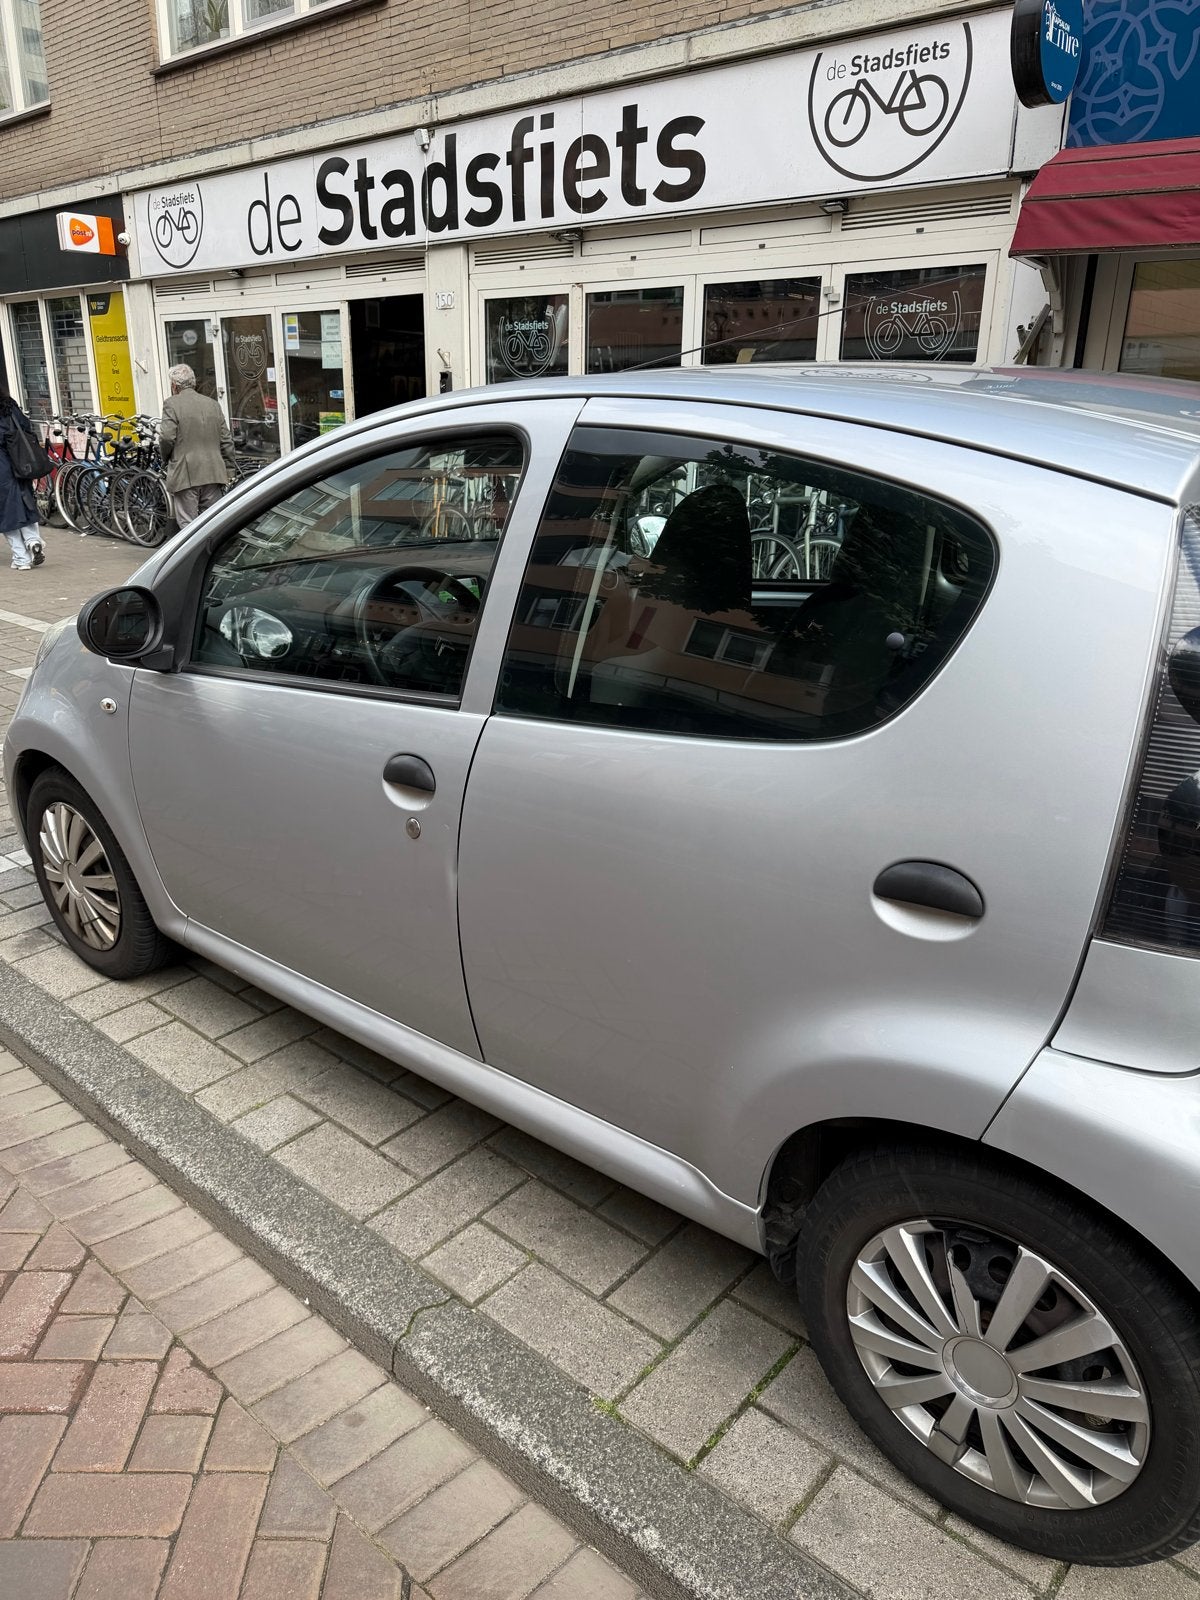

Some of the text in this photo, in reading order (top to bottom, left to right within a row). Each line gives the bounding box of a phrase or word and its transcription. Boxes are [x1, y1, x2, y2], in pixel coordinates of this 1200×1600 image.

[826, 41, 950, 81] de Stadsfiets
[247, 104, 707, 256] de Stadsfiets
[152, 192, 195, 210] de Stadsfiets
[437, 293, 453, 308] 150
[875, 300, 948, 315] de Stadsfiets
[504, 320, 549, 331] de Stadsfiets
[240, 334, 262, 343] Stadsfiets
